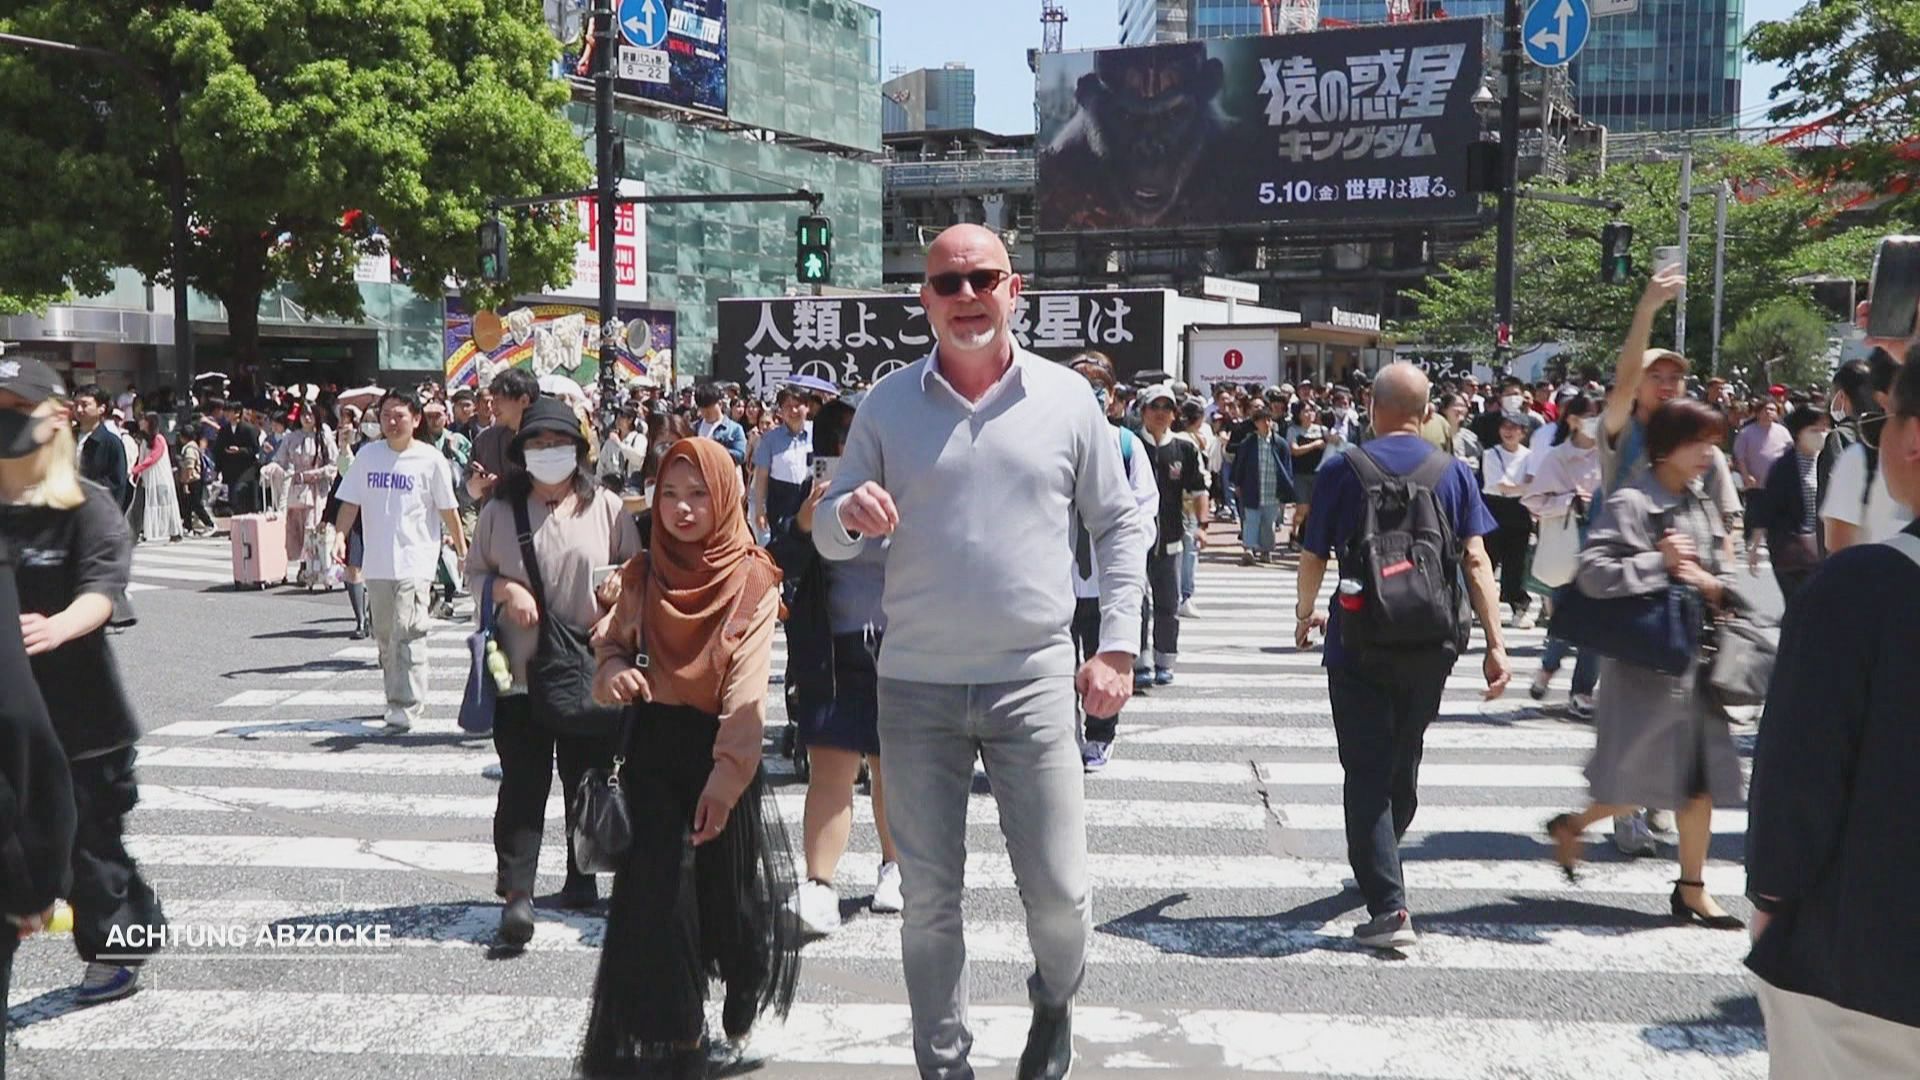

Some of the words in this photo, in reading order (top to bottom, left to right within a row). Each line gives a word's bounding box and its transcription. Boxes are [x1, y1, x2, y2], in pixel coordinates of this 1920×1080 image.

[1256, 43, 1467, 126] 猿の惑星
[1278, 123, 1437, 163] キングダム
[1345, 175, 1456, 201] 世界は覆る。
[367, 472, 415, 491] FRIENDS
